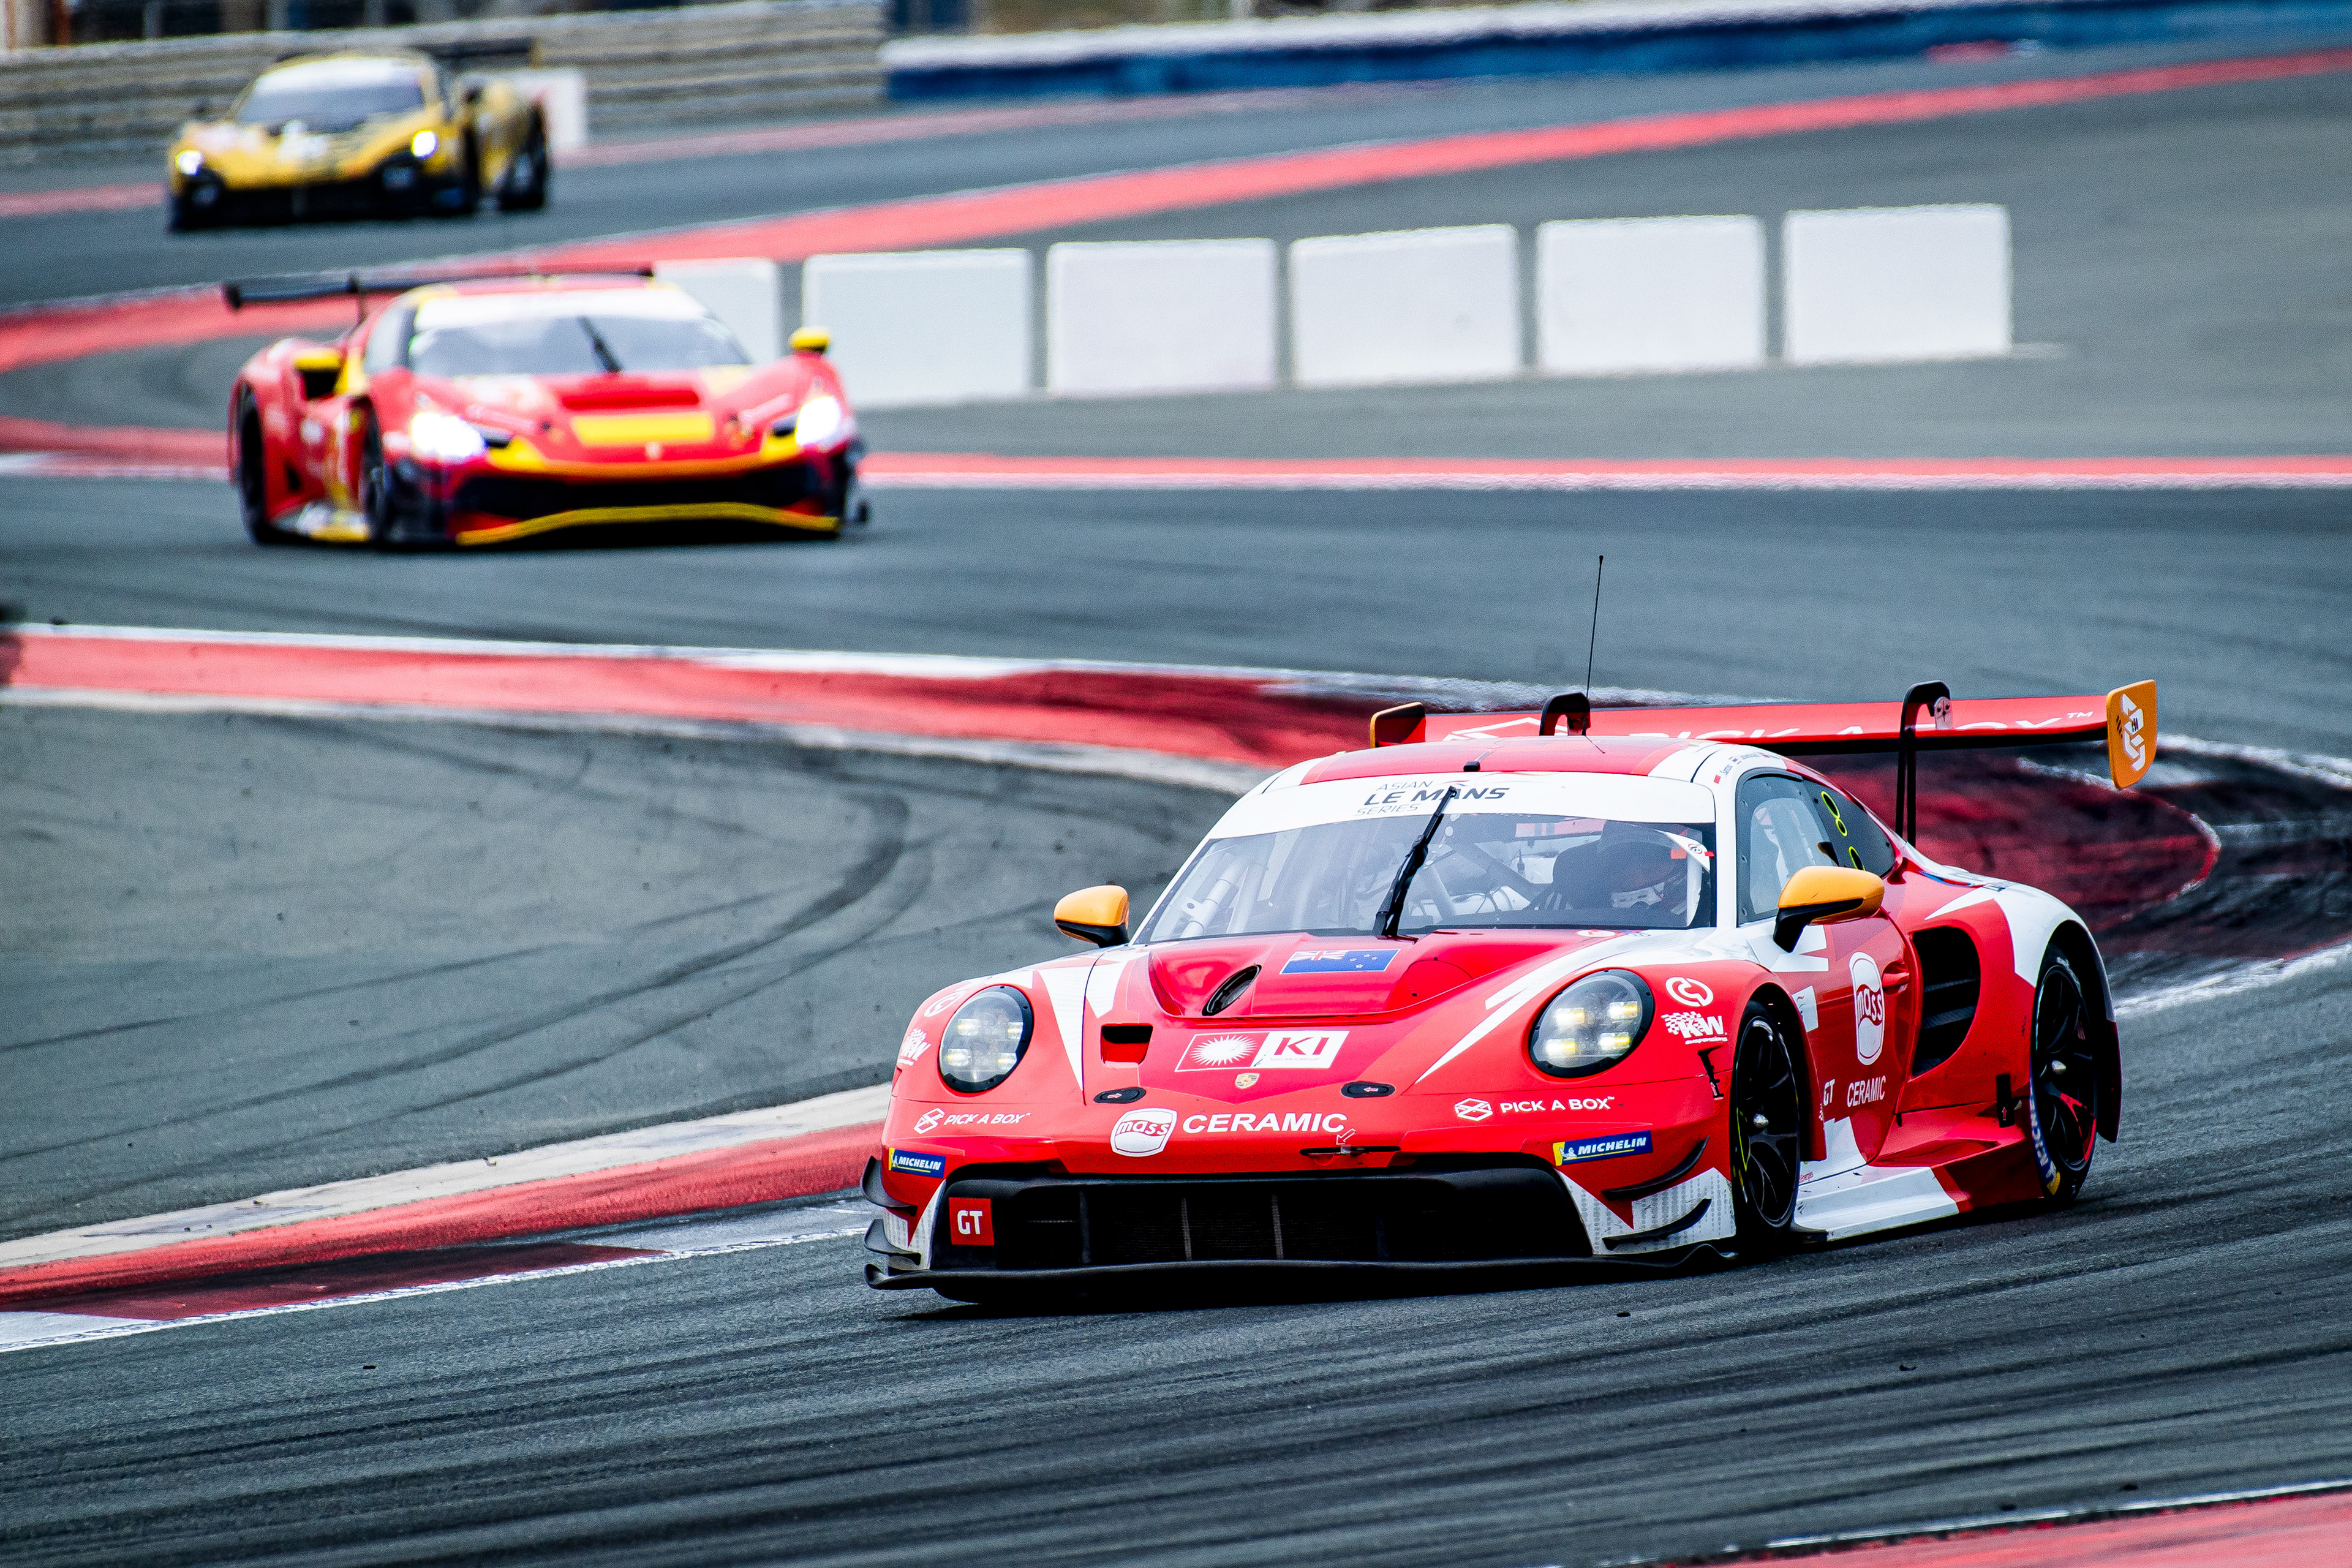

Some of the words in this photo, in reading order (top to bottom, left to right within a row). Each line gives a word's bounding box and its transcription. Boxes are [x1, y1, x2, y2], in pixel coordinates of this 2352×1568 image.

[1376, 780, 1433, 791] ASIAN
[1364, 791, 1406, 805] LE
[1355, 804, 1420, 815] SERIES
[1856, 988, 1882, 1023] mass
[1273, 1036, 1331, 1055] KI
[1823, 1079, 1835, 1106] GT
[1847, 1076, 1886, 1107] CERAMIC
[1500, 1100, 1545, 1113] PICK
[1551, 1099, 1566, 1111] A
[943, 1114, 979, 1126] PICK
[977, 1114, 990, 1125] A
[1117, 1120, 1170, 1136] mass
[1182, 1113, 1348, 1134] CERAMIC
[1577, 1137, 1647, 1155] MICHELIN
[898, 1156, 941, 1170] MICHELIN
[957, 1210, 982, 1235] GT
